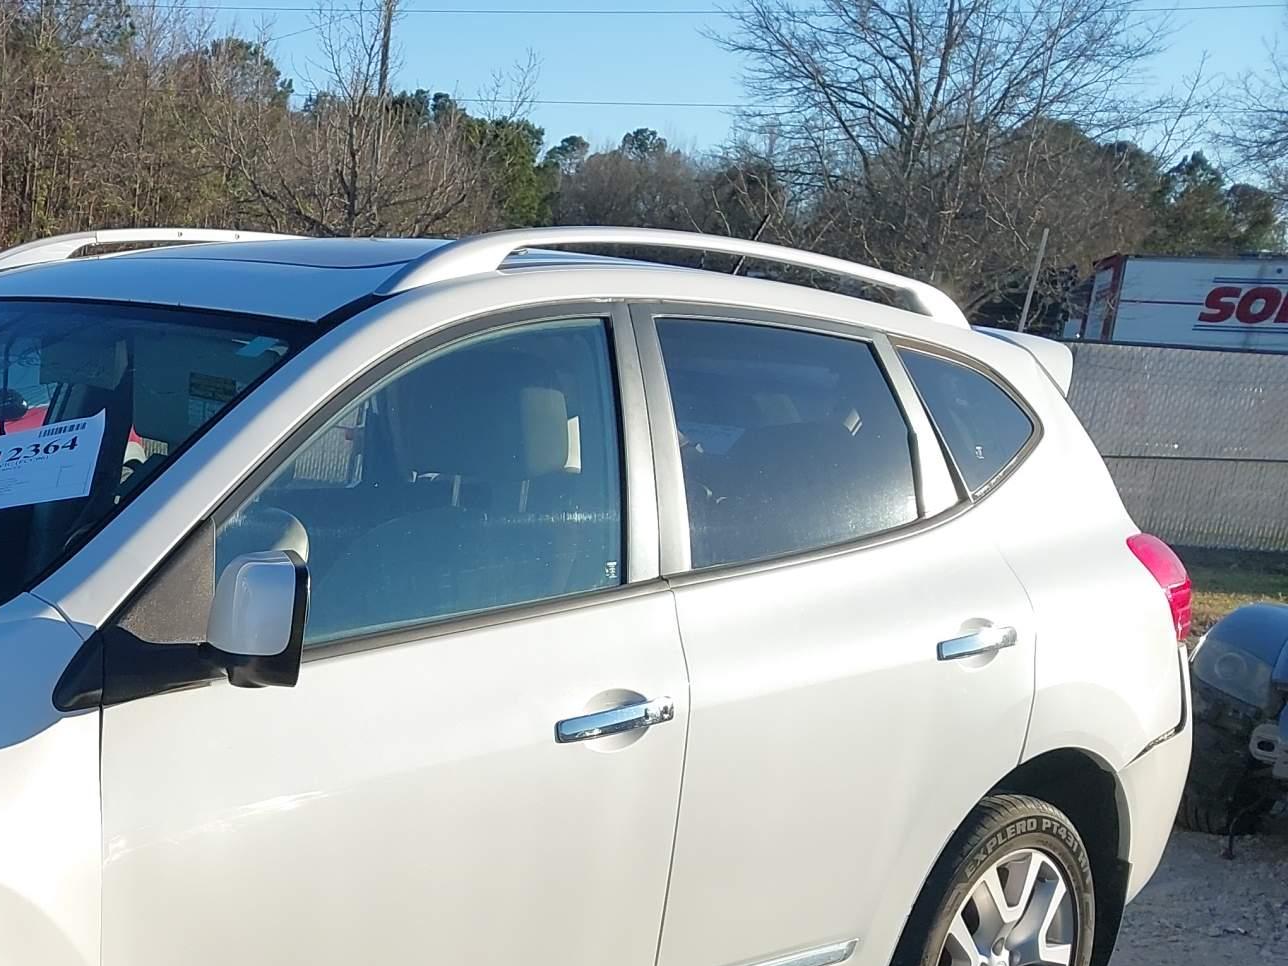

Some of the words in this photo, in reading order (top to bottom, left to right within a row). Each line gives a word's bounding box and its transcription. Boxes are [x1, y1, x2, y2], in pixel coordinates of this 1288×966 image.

[1198, 286, 1288, 324] SO
[965, 818, 1038, 878] EXPLERO
[1041, 817, 1079, 854] PT431
